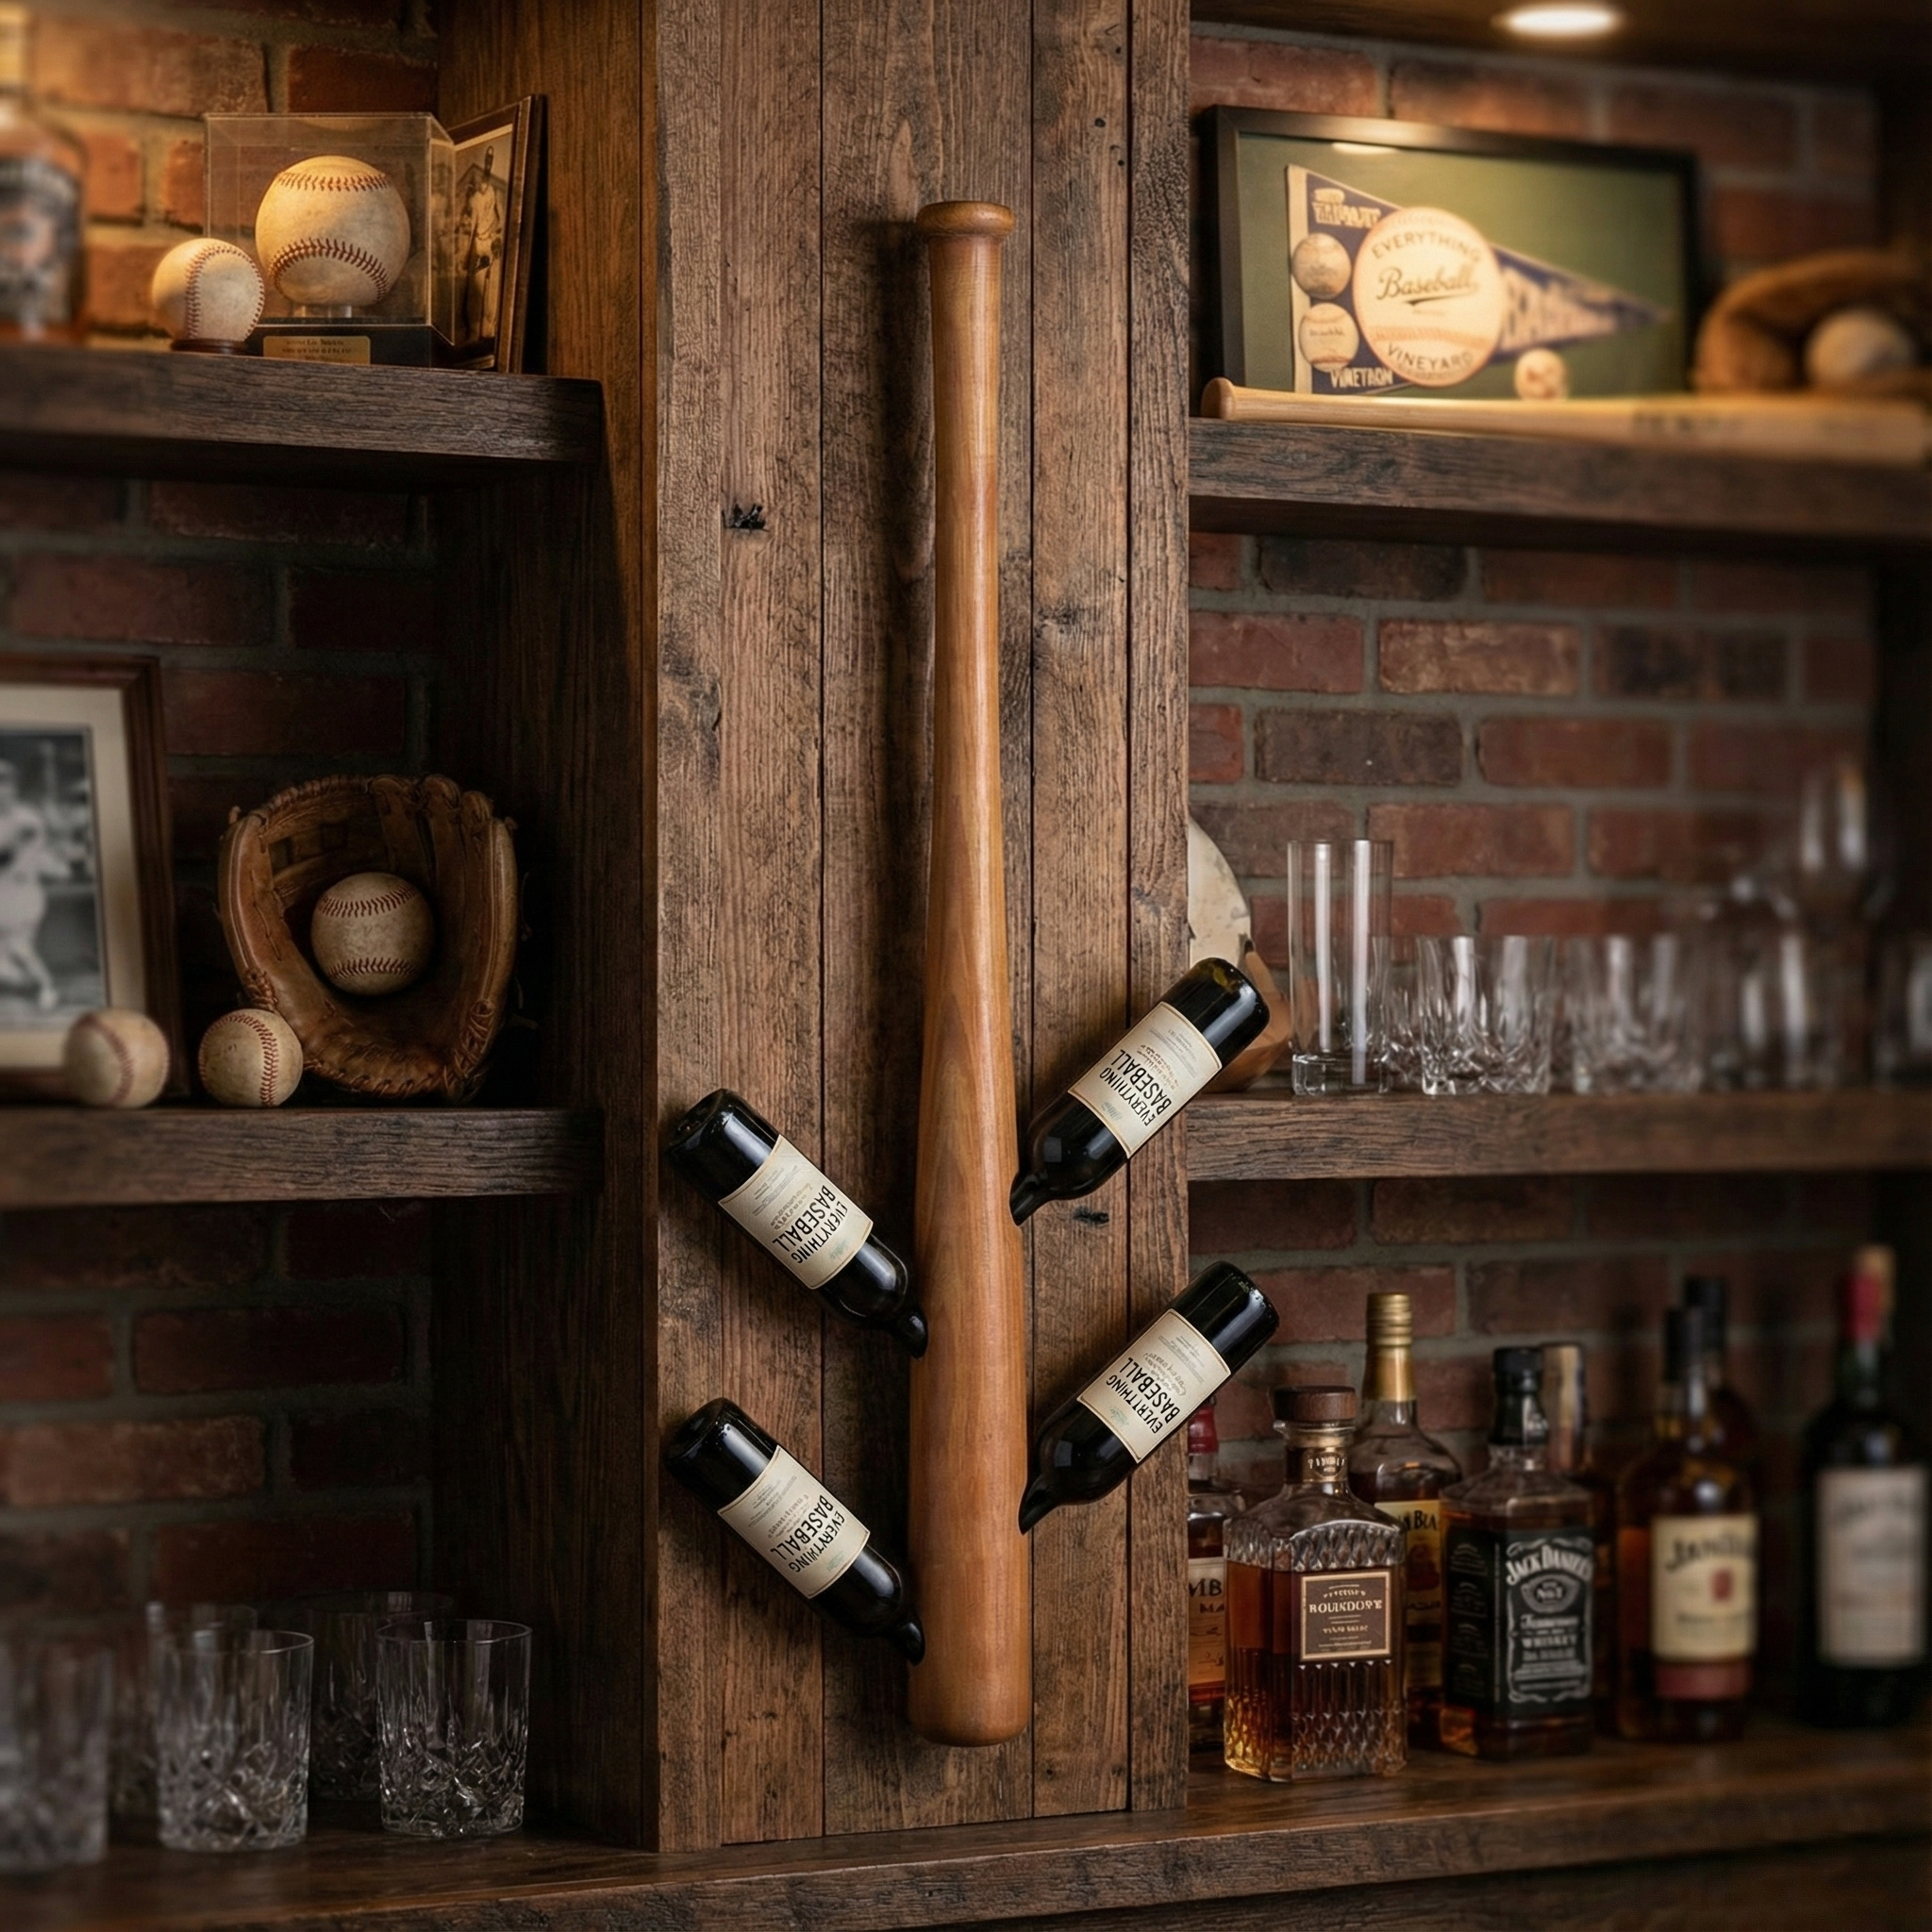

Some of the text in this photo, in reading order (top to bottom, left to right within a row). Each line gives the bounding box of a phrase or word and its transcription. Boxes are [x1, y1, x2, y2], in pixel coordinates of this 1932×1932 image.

[1372, 231, 1480, 263] EVERYTHING
[1388, 342, 1474, 371] VINEYARD
[1110, 1049, 1173, 1115] BASEBALL
[772, 1185, 837, 1253] BASEBALL
[1119, 1357, 1181, 1424] BASEBALL
[770, 1494, 834, 1560] BASEBALL
[1506, 1553, 1542, 1586] JACK
